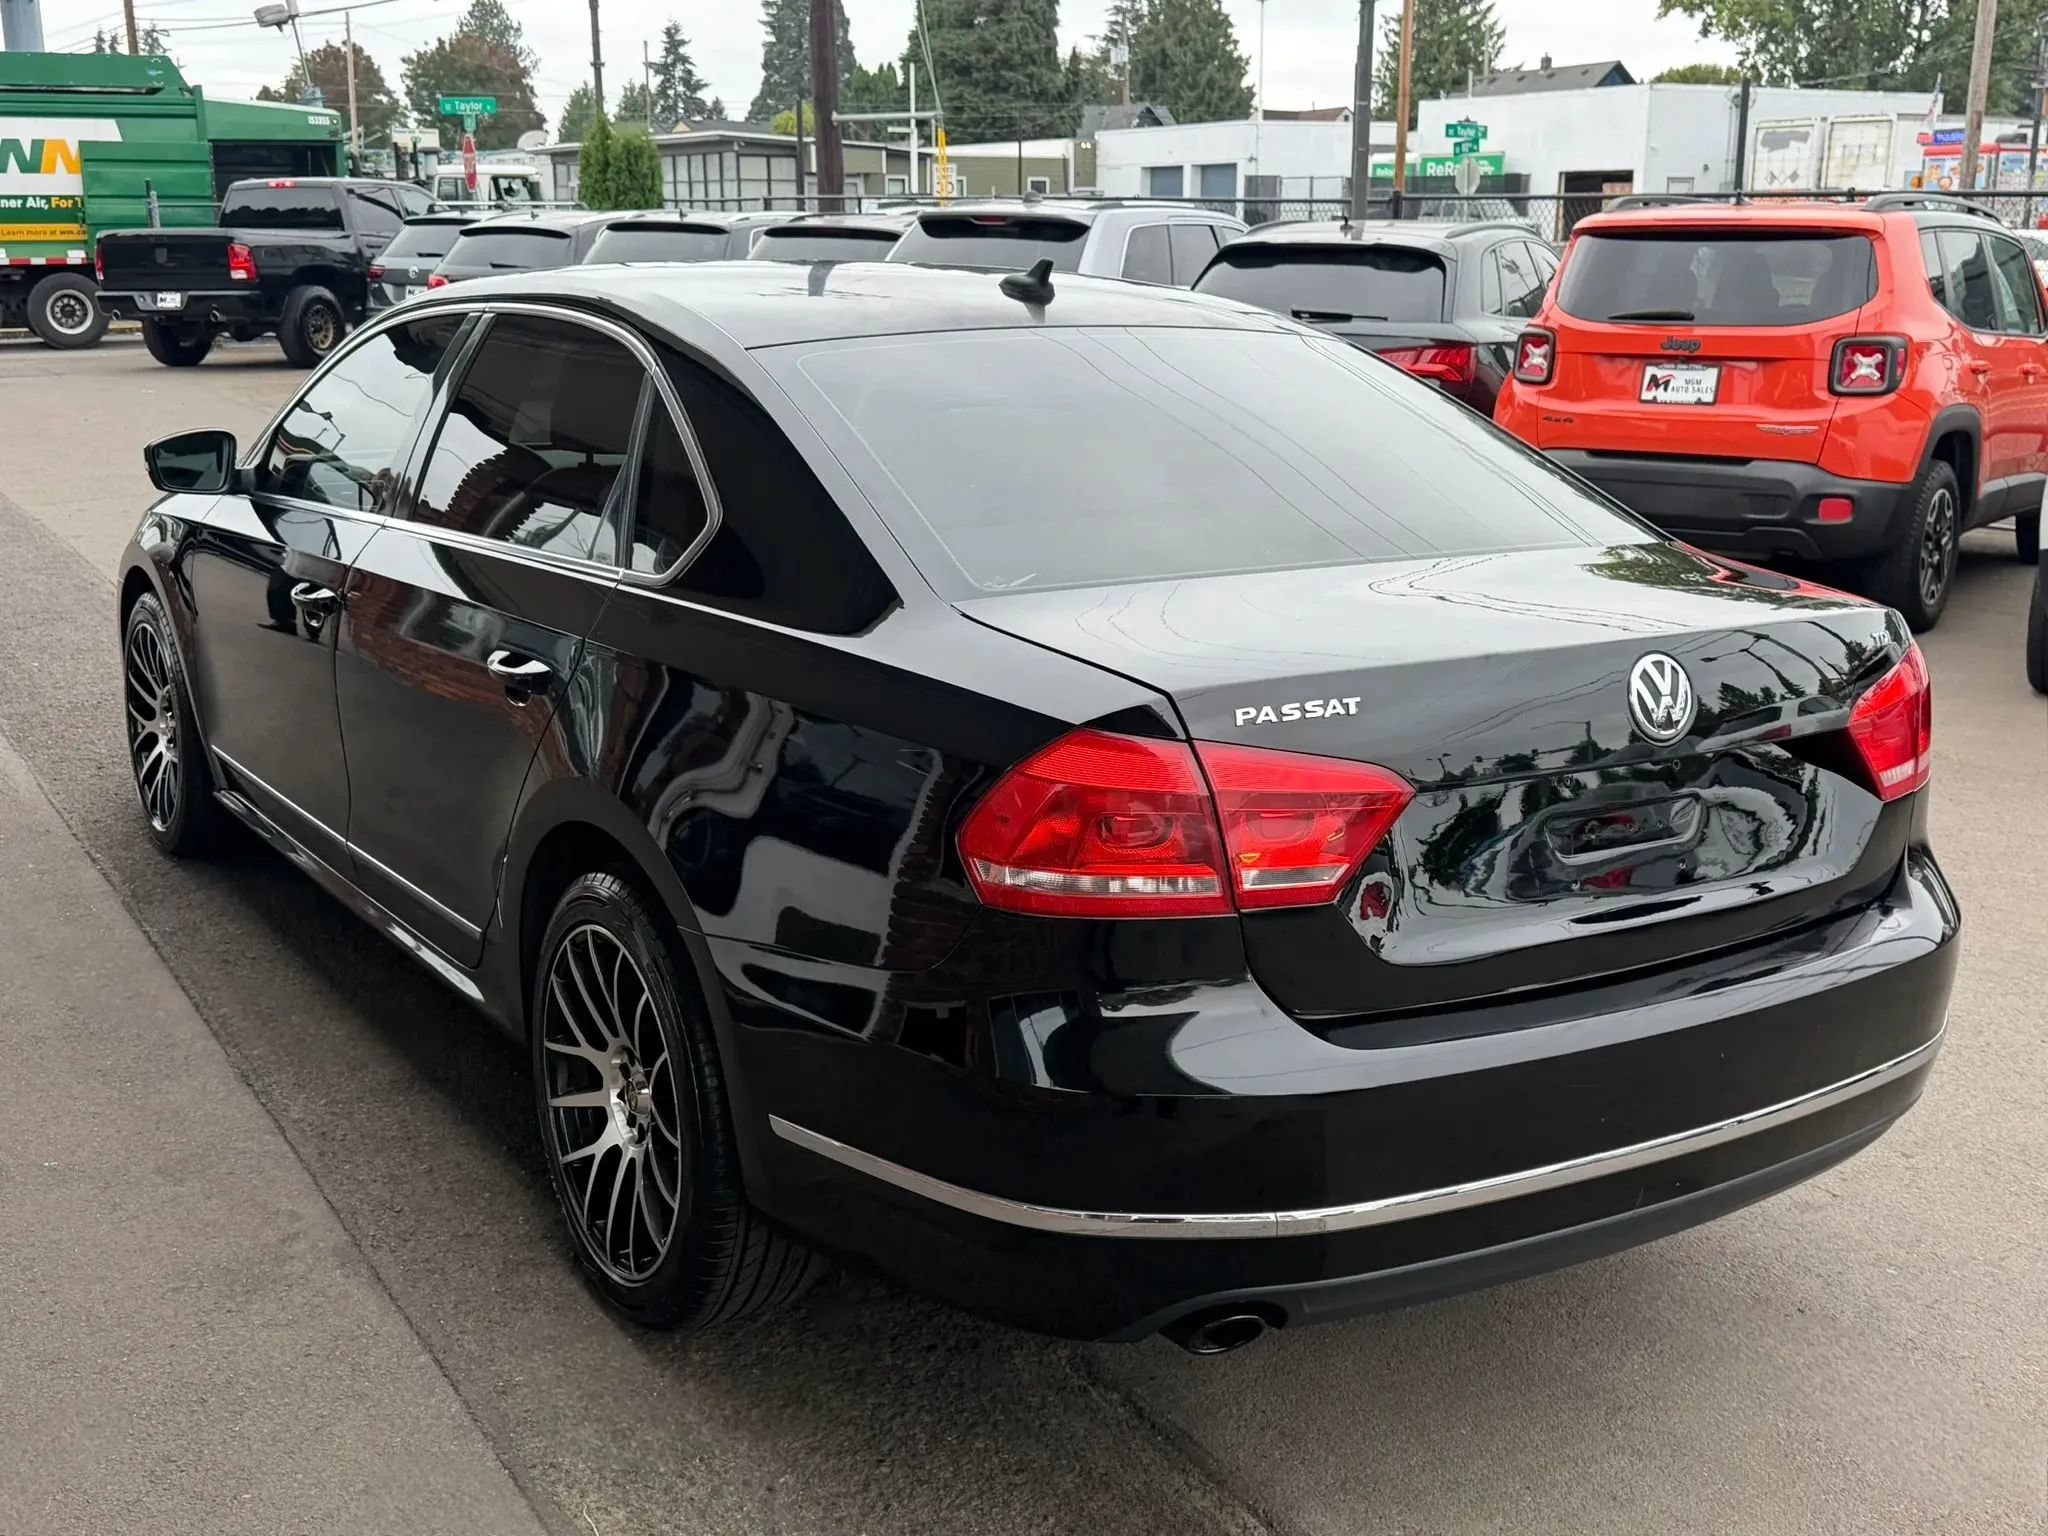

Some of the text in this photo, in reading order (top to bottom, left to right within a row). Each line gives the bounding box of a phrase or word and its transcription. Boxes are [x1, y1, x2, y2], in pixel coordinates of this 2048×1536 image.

[454, 101, 483, 113] Taylor
[26, 197, 49, 210] Air,
[51, 197, 73, 208] For
[1661, 335, 1701, 353] Jeep
[1234, 696, 1361, 727] PASSAT
